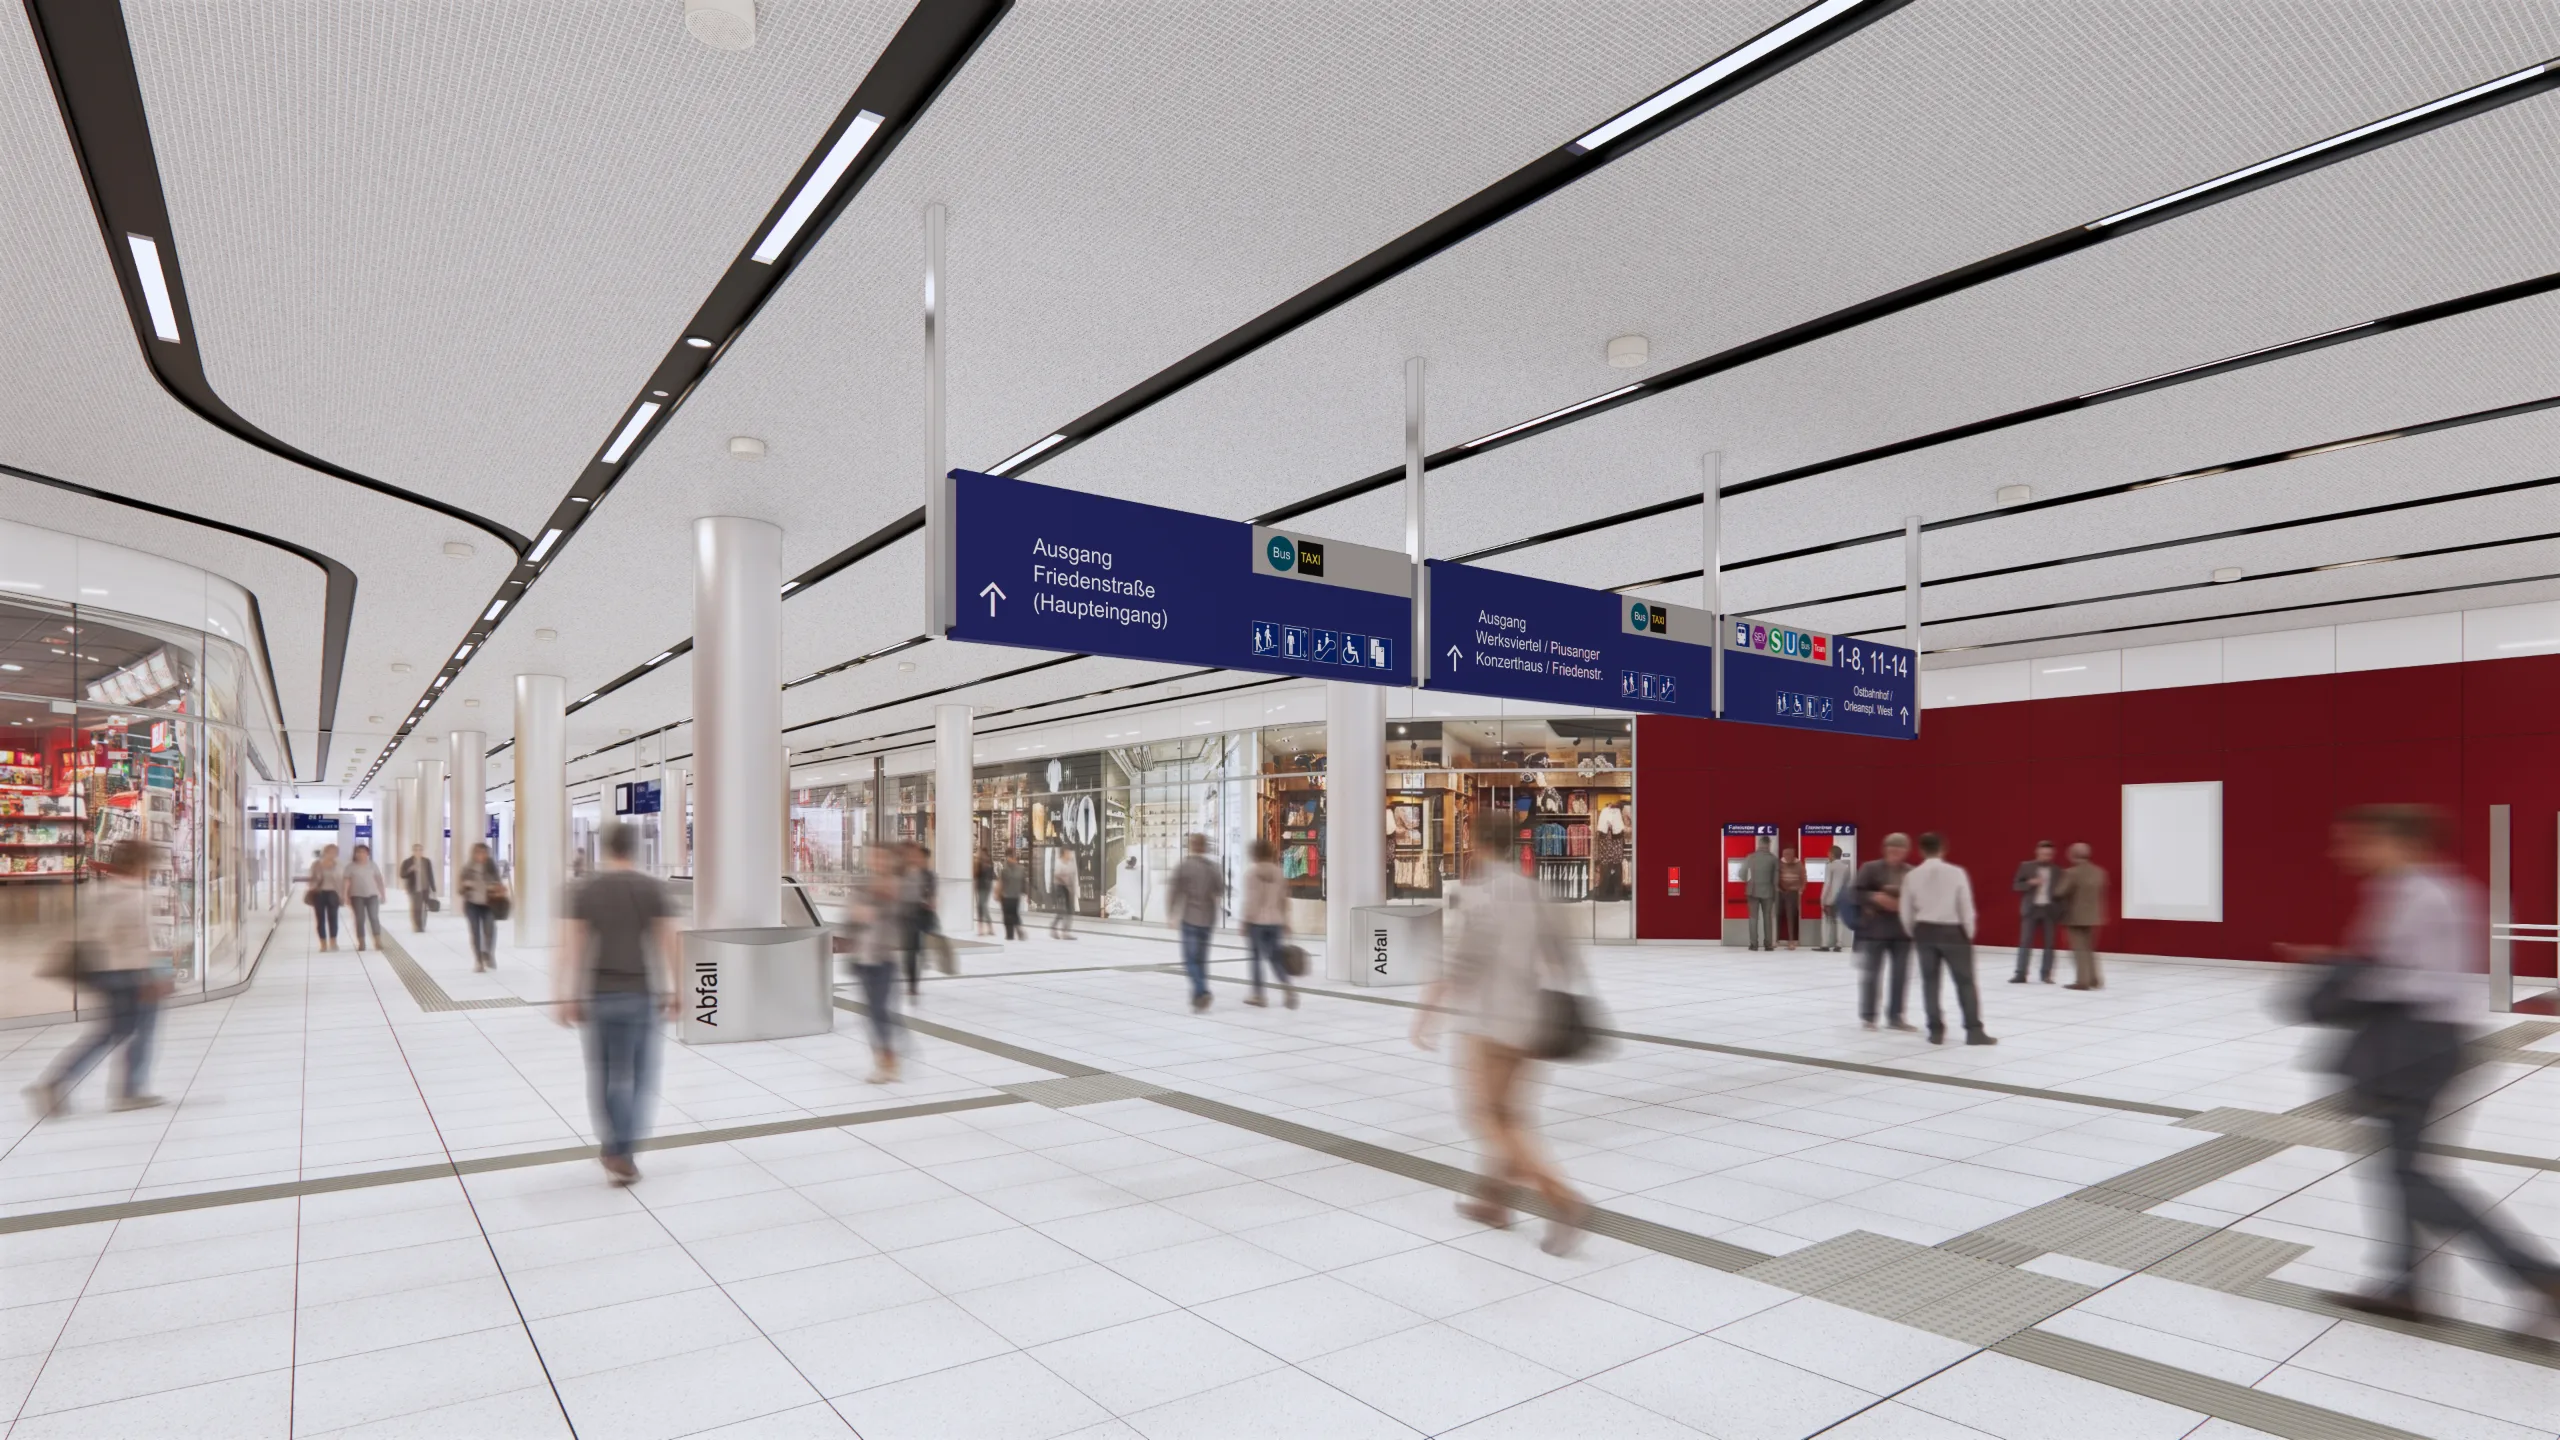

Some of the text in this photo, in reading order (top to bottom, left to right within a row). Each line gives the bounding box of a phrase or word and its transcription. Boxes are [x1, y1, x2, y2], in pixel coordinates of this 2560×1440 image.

[1033, 538, 1112, 570] Ausgang
[1273, 546, 1291, 560] Bus
[1300, 551, 1321, 565] TAXI
[1034, 565, 1155, 598] Friedenstraße
[1033, 593, 1168, 630] (Haupteingang)
[1478, 609, 1527, 633] Ausgang
[1634, 611, 1646, 622] Bus
[1652, 614, 1665, 625] TAXI
[1475, 630, 1600, 662] Werksviertel / Piusanger
[1754, 632, 1766, 643] SEV
[1771, 631, 1781, 651] S
[1786, 634, 1796, 654] U
[1801, 639, 1810, 650] Bus
[1814, 643, 1826, 653] Tram
[1475, 651, 1604, 681] Konzerthaus / Friedenstr.
[1838, 644, 1908, 678] 1-8, 11-14
[1853, 685, 1890, 700] Ostbahnhof
[1843, 700, 1893, 717] Orleanspl. West
[1374, 929, 1388, 975] Abfall
[695, 962, 718, 1027] Abfall
